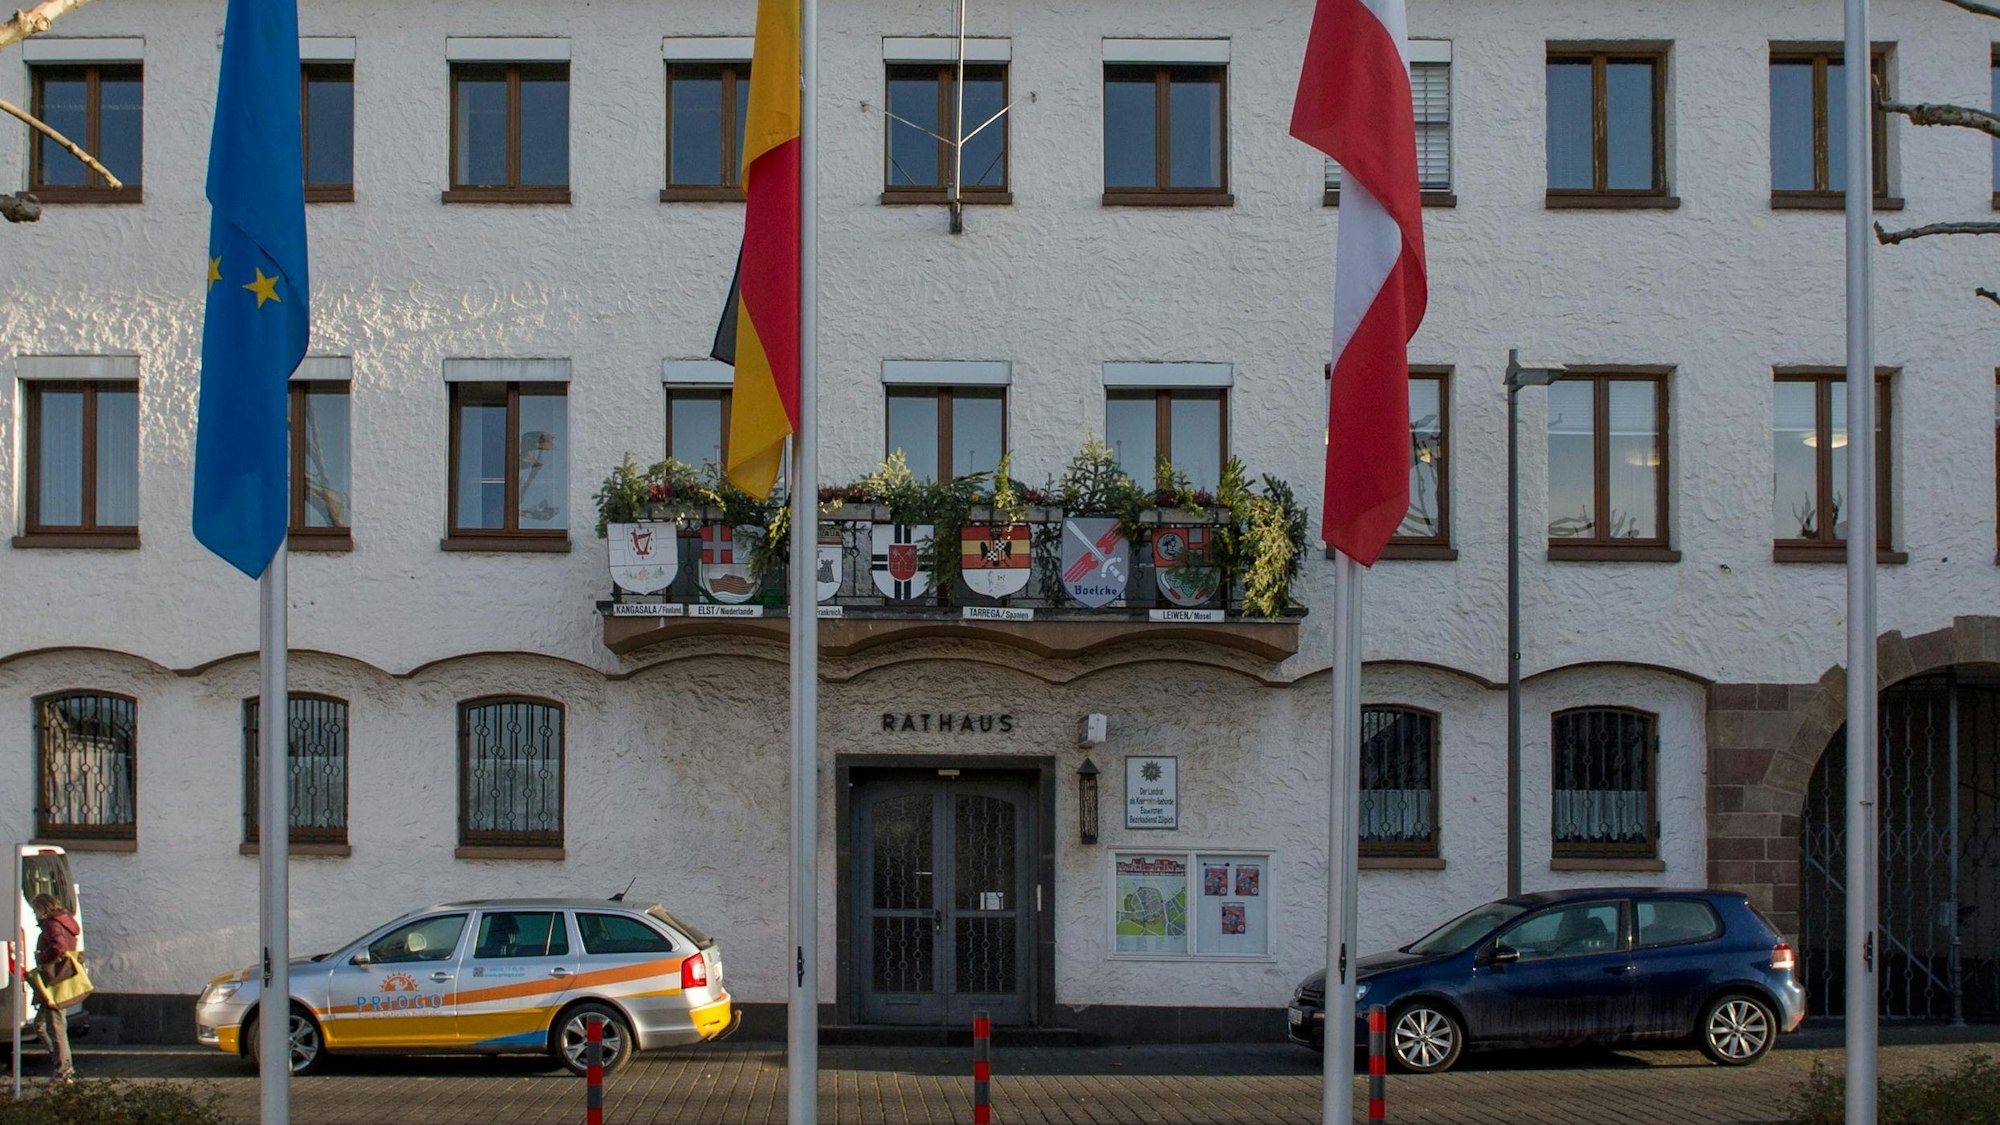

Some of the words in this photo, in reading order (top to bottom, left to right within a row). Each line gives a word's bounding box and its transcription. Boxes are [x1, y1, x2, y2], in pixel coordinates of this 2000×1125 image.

[1074, 584, 1118, 596] Boelcke
[1162, 611, 1212, 620] LEIWEN/Mosel
[882, 713, 1013, 733] RATHAUS
